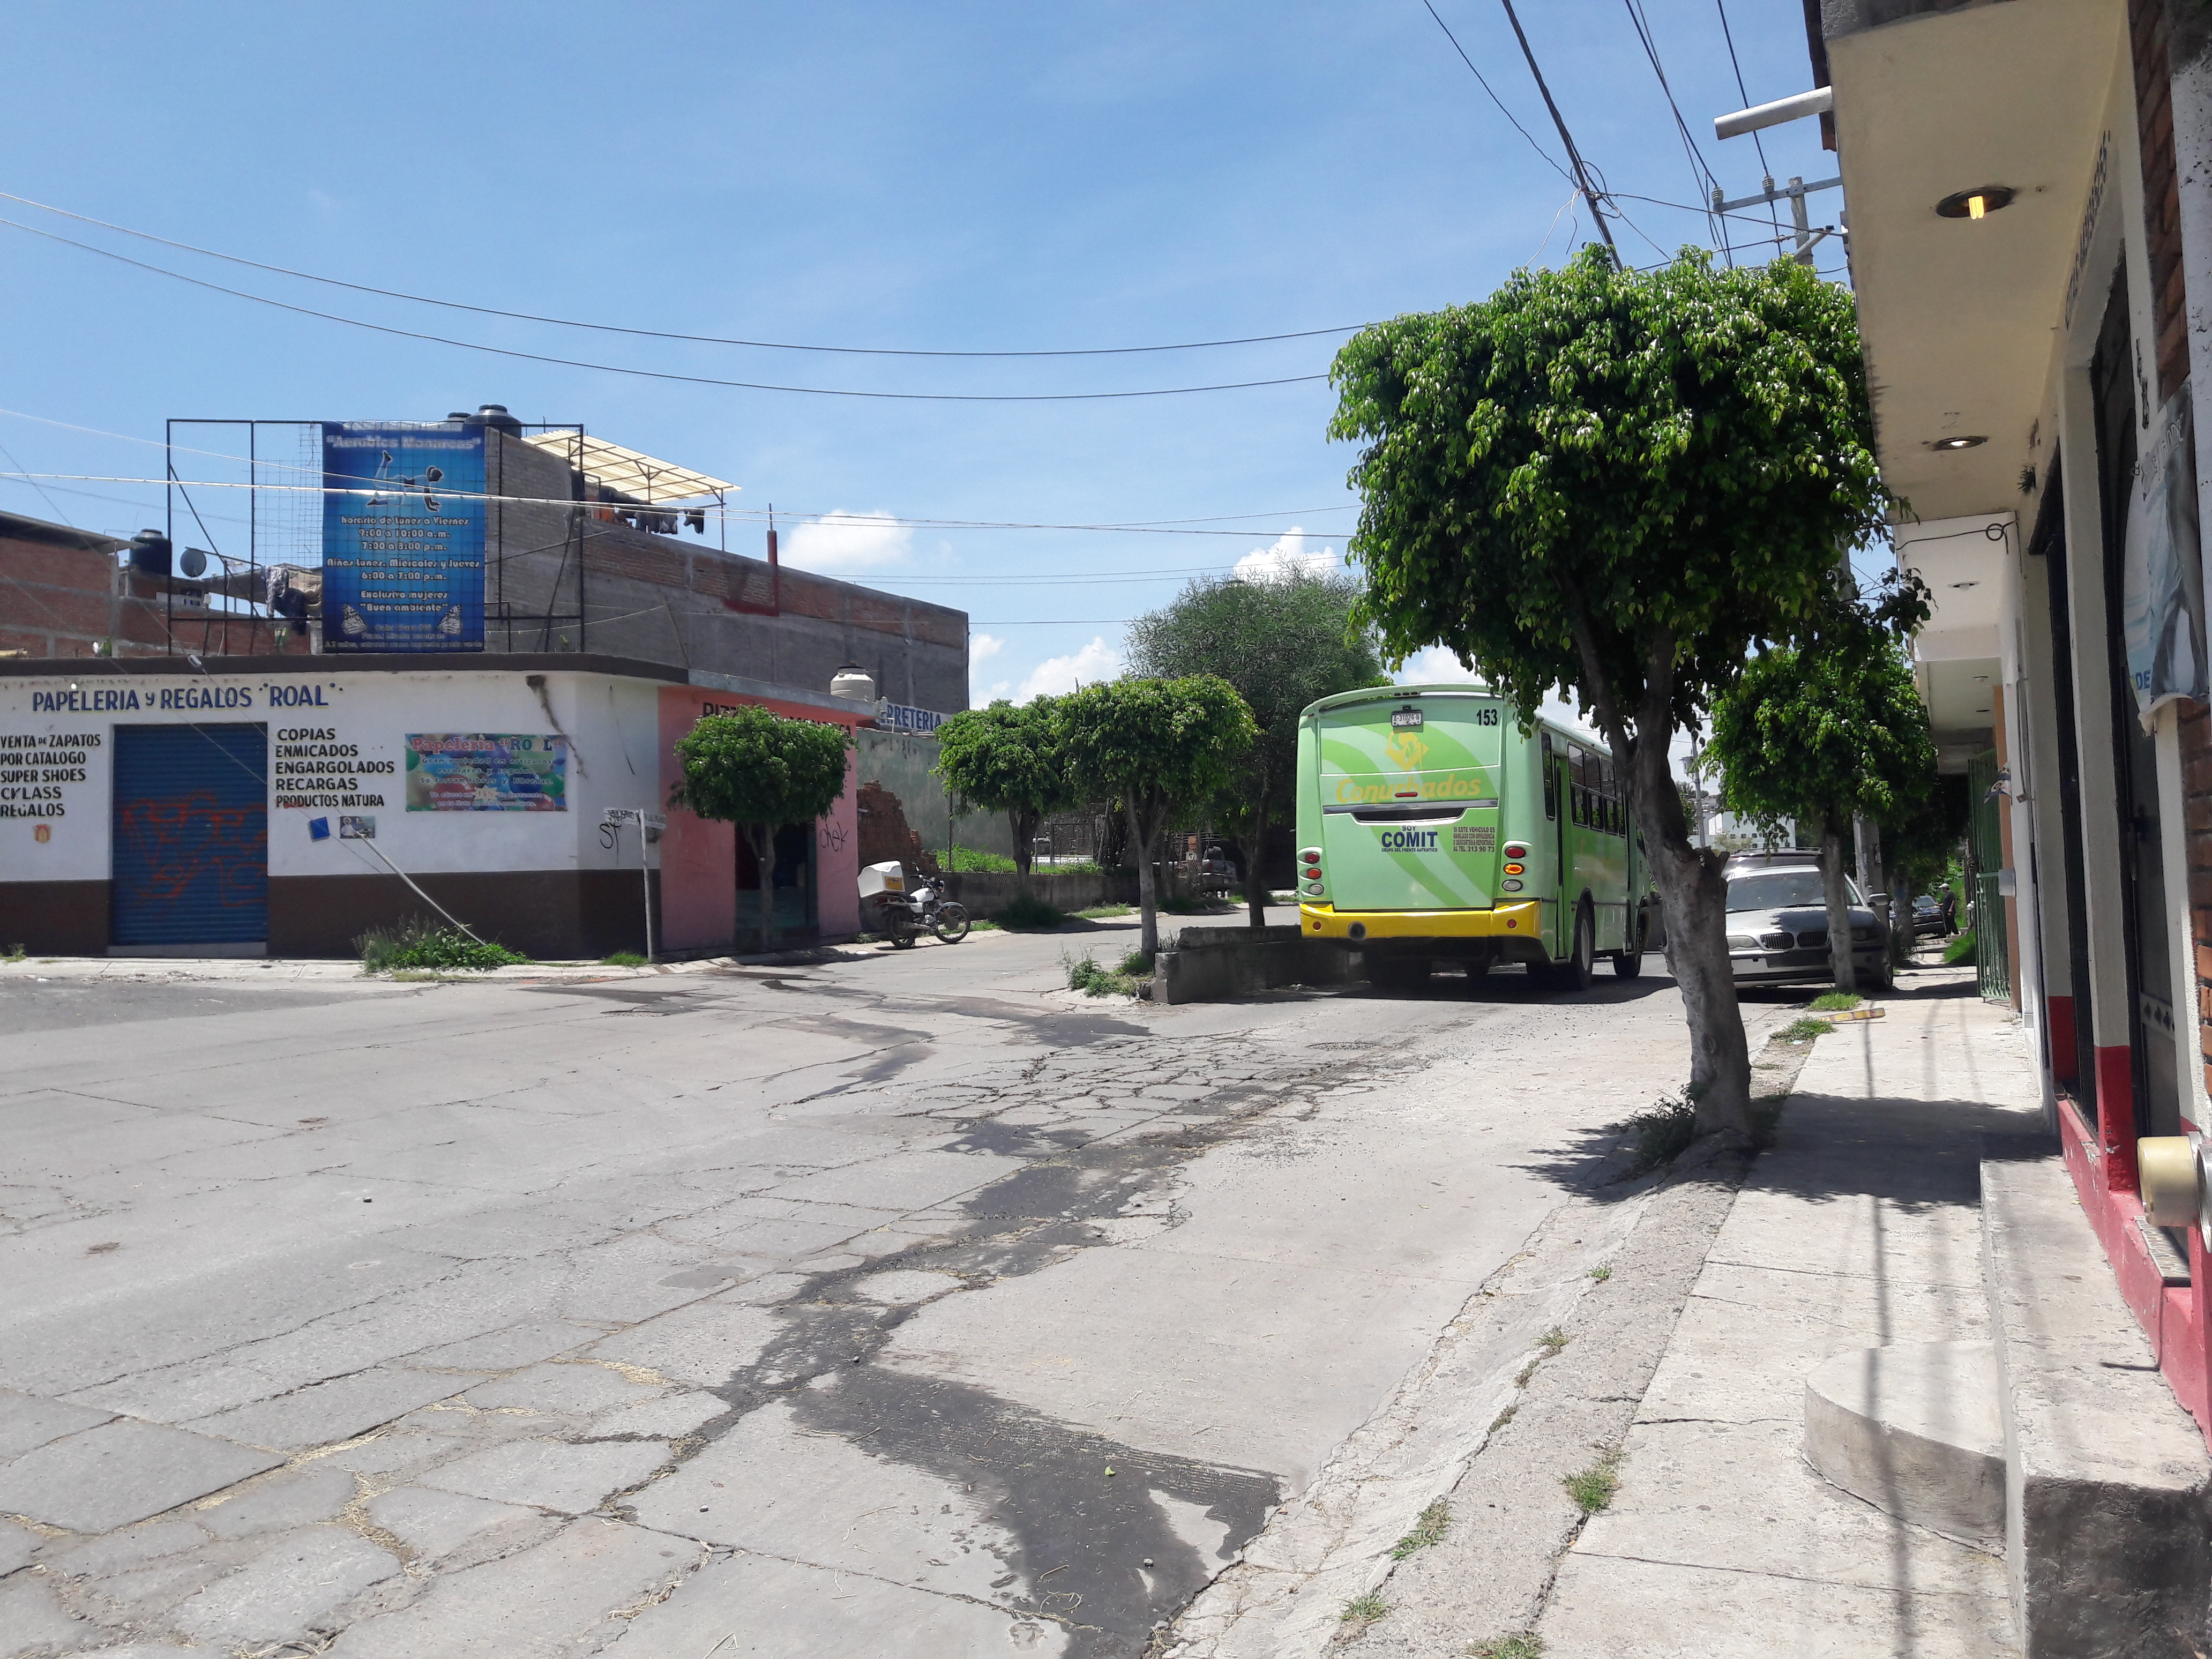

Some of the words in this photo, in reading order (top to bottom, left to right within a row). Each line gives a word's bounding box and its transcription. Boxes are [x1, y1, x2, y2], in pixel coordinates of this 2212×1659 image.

[379, 515, 392, 525] de
[433, 516, 469, 525] Viernes
[395, 529, 424, 537] 10:00
[362, 541, 385, 550] 7:00
[423, 544, 447, 552] p.m.
[440, 560, 446, 570] y
[448, 558, 480, 567] Jueves
[361, 571, 385, 580] 6:00
[398, 571, 421, 580] 7:00
[423, 573, 446, 582] p.m.
[361, 590, 406, 599] Exclusivo
[408, 590, 448, 601] mujeres
[33, 689, 139, 712] PAPELERIA
[161, 686, 252, 709] REGALOS
[1476, 708, 1498, 726] 153
[1, 734, 36, 748] VENTA
[38, 737, 47, 745] DE
[49, 734, 101, 748] ZAPATOS
[277, 728, 335, 741] COPIAS
[1, 752, 23, 765] POR
[26, 751, 86, 765] CATALOGO
[275, 744, 358, 758] ENMICADOS
[275, 760, 394, 774] ENGARGOLADOS
[1, 769, 38, 782] SUPER
[42, 768, 86, 782] SHOES
[276, 778, 358, 790] RECARGAS
[1336, 773, 1482, 804] Conurbados
[276, 795, 339, 808] PRODUCTOS
[341, 794, 385, 806] NATURA
[1381, 832, 1438, 847] COMIT
